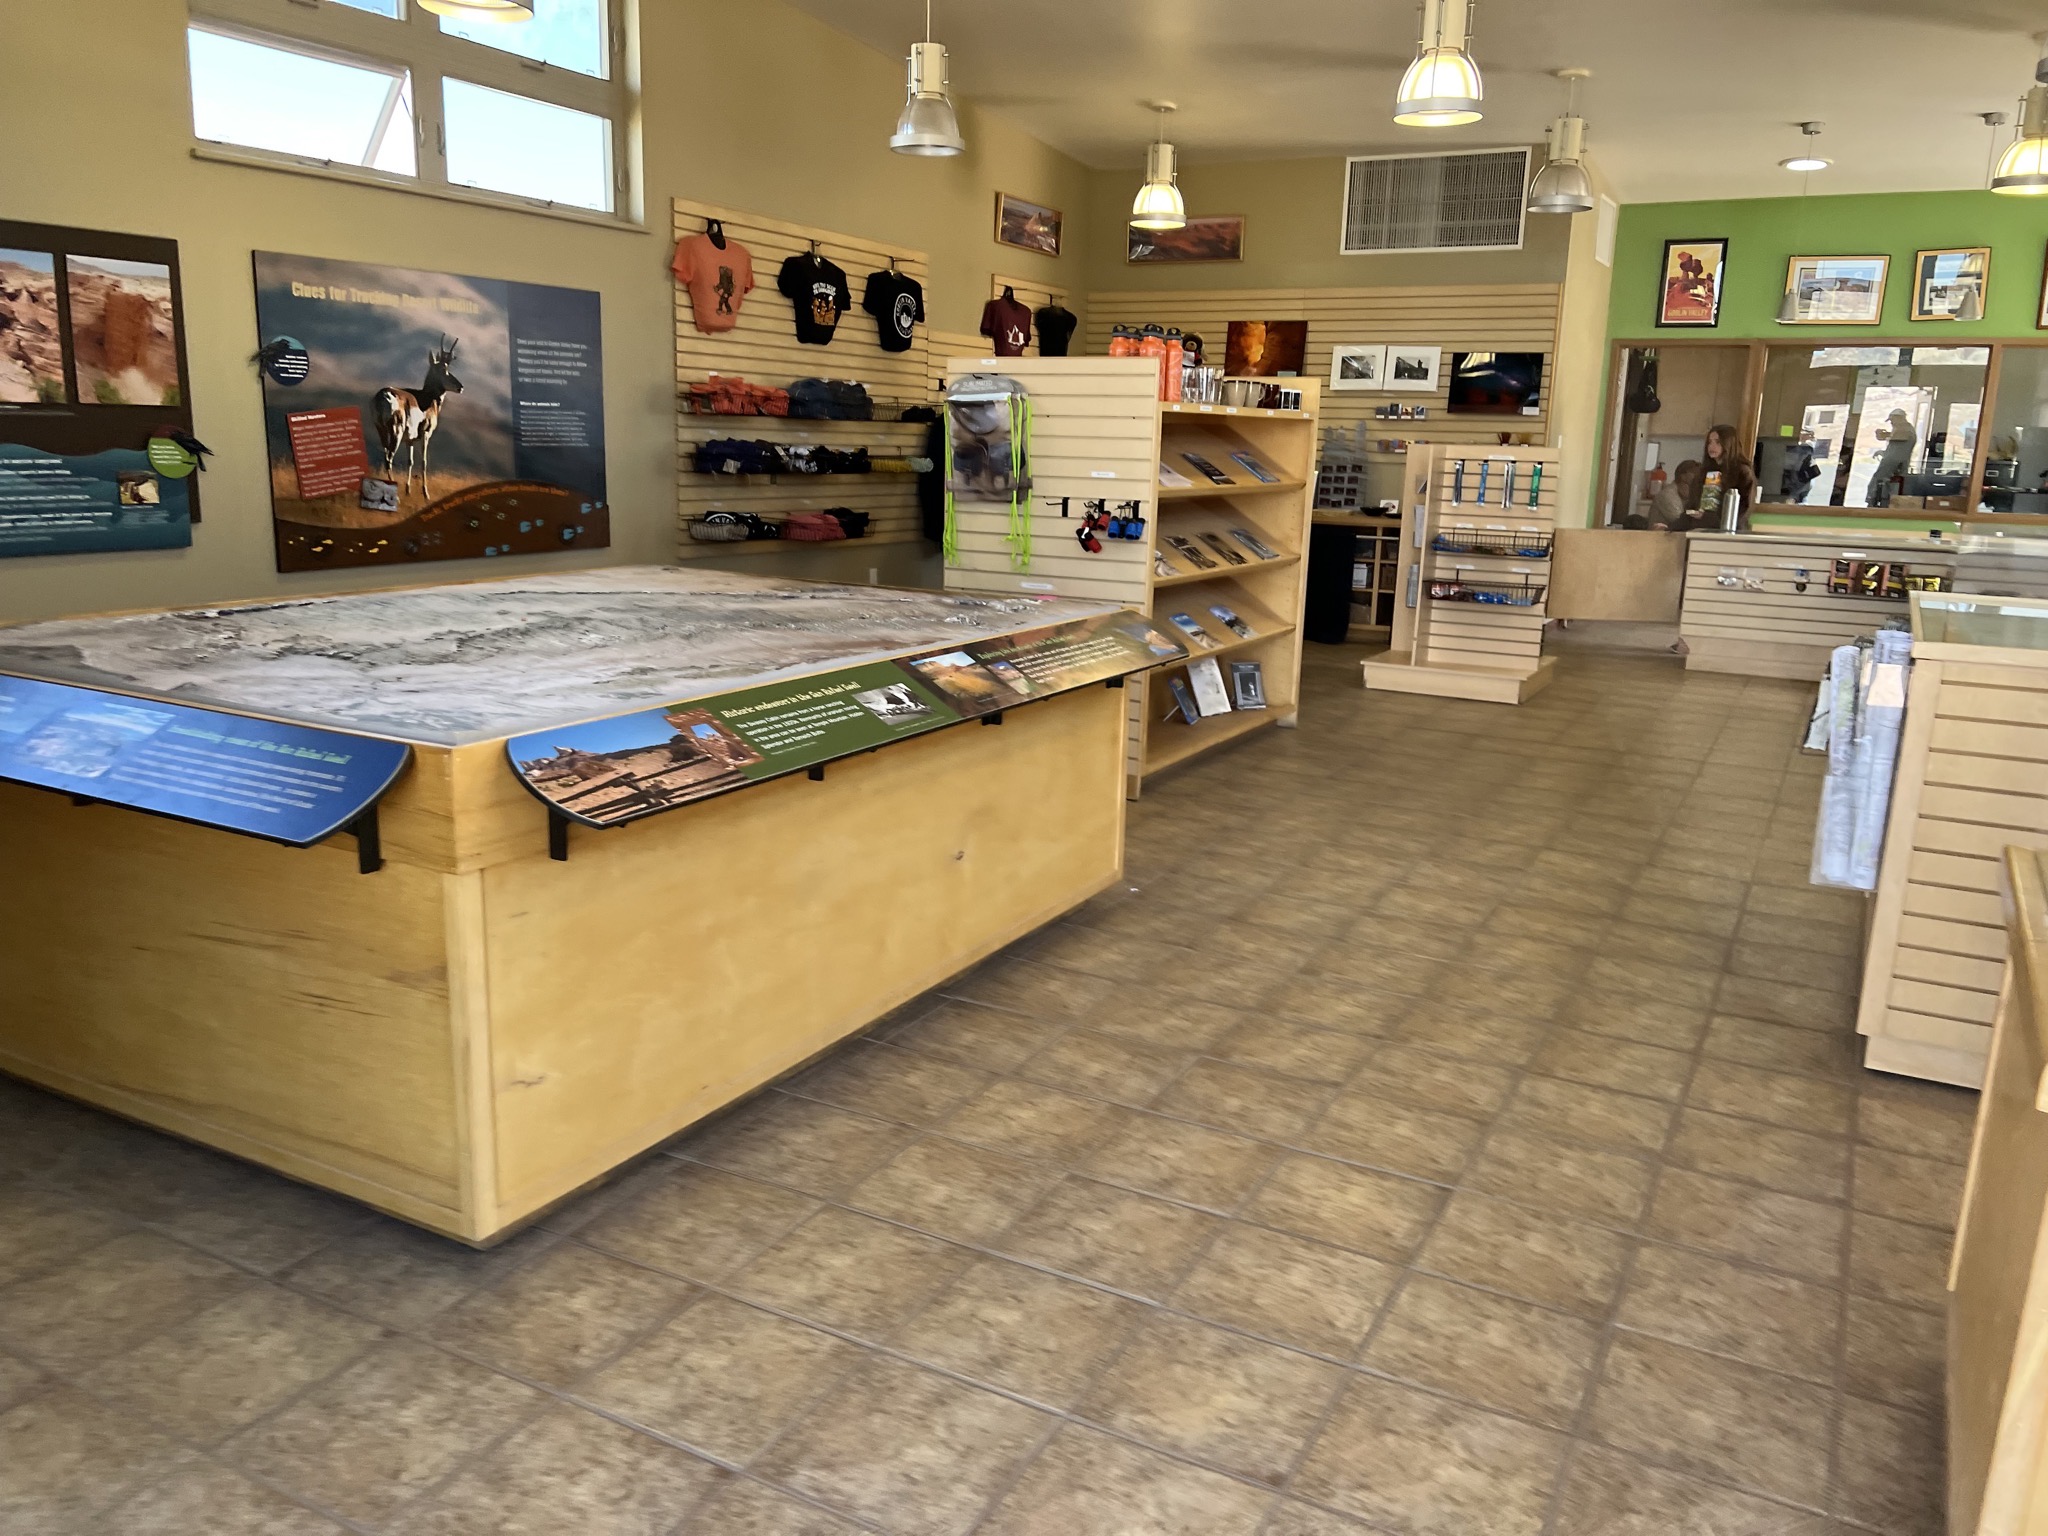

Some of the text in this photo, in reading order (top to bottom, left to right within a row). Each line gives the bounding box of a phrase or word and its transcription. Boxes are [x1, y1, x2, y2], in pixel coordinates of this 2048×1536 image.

[292, 281, 326, 299] Clues
[329, 286, 347, 301] for
[720, 706, 756, 718] Historic
[797, 693, 812, 702] the
[809, 690, 824, 698] San
[841, 681, 862, 691] Swell
